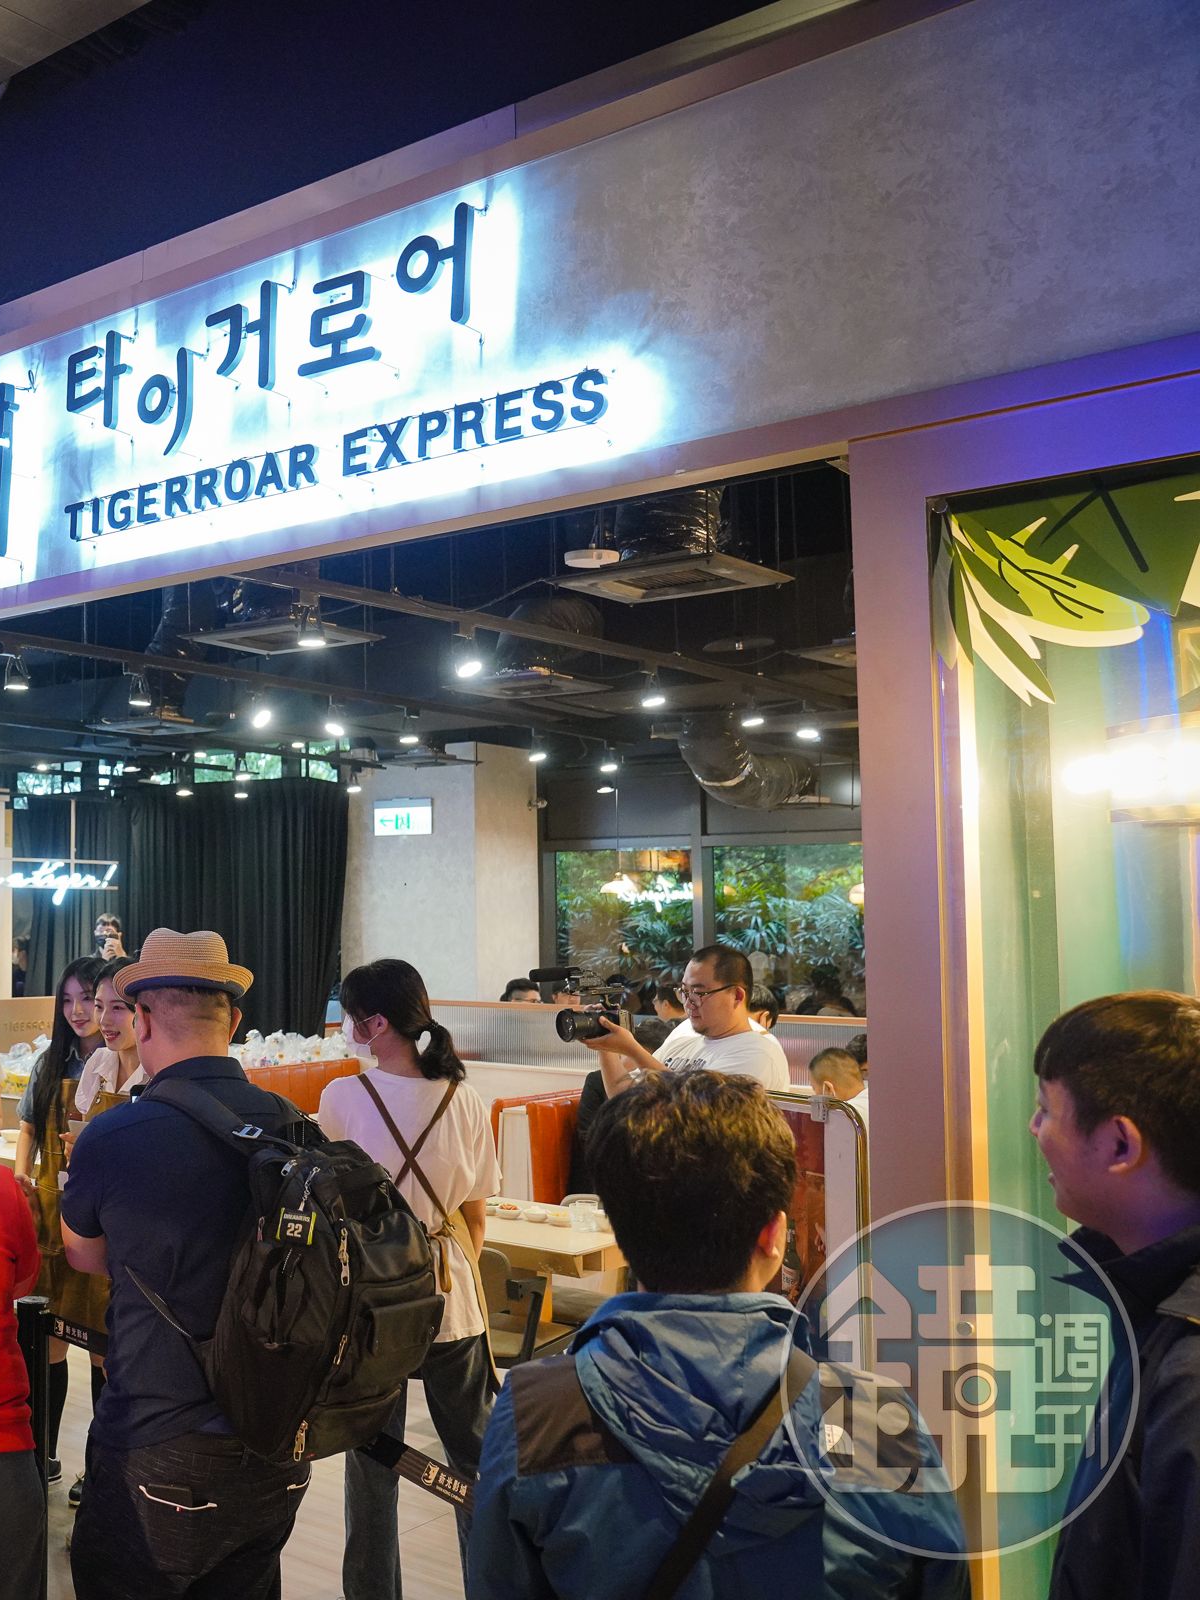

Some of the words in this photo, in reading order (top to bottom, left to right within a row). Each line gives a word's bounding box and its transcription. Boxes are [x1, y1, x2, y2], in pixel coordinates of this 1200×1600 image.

[67, 202, 478, 456] 타이거로어
[65, 442, 319, 542] TIGERROAR
[341, 368, 610, 478] EXPRESS
[287, 1223, 302, 1238] 22
